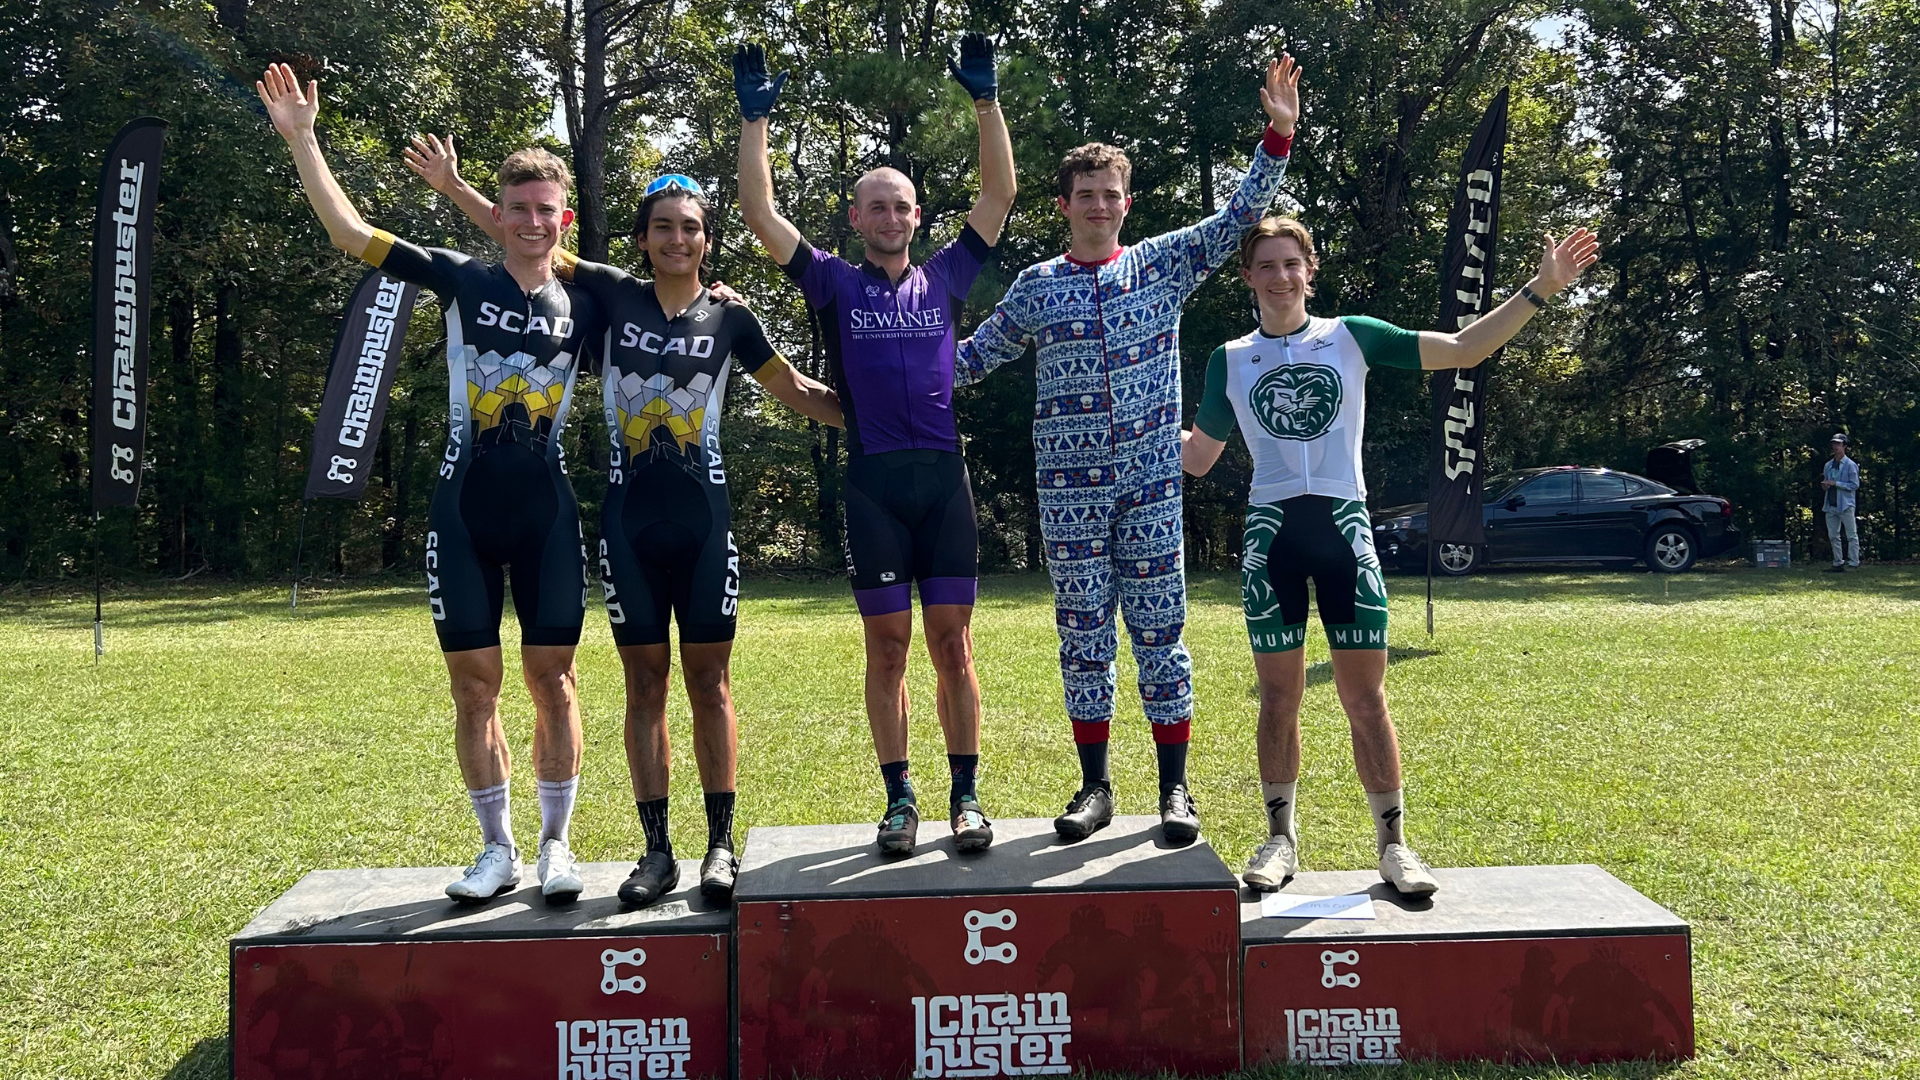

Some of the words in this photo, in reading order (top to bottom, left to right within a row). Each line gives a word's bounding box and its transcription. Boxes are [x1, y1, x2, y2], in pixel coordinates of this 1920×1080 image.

[112, 158, 144, 431] Chainbuster
[476, 302, 574, 340] SCAD
[338, 276, 406, 449] Chainbuster
[619, 322, 715, 359] SCAD
[440, 402, 464, 480] SCAD
[605, 407, 623, 485] SCAD
[706, 415, 726, 485] SCAD
[426, 530, 447, 621] SCAD
[570, 1017, 691, 1054] Chain
[912, 996, 1072, 1079] buster
[929, 991, 1072, 1037] Chain
[1297, 1007, 1401, 1038] Chain
